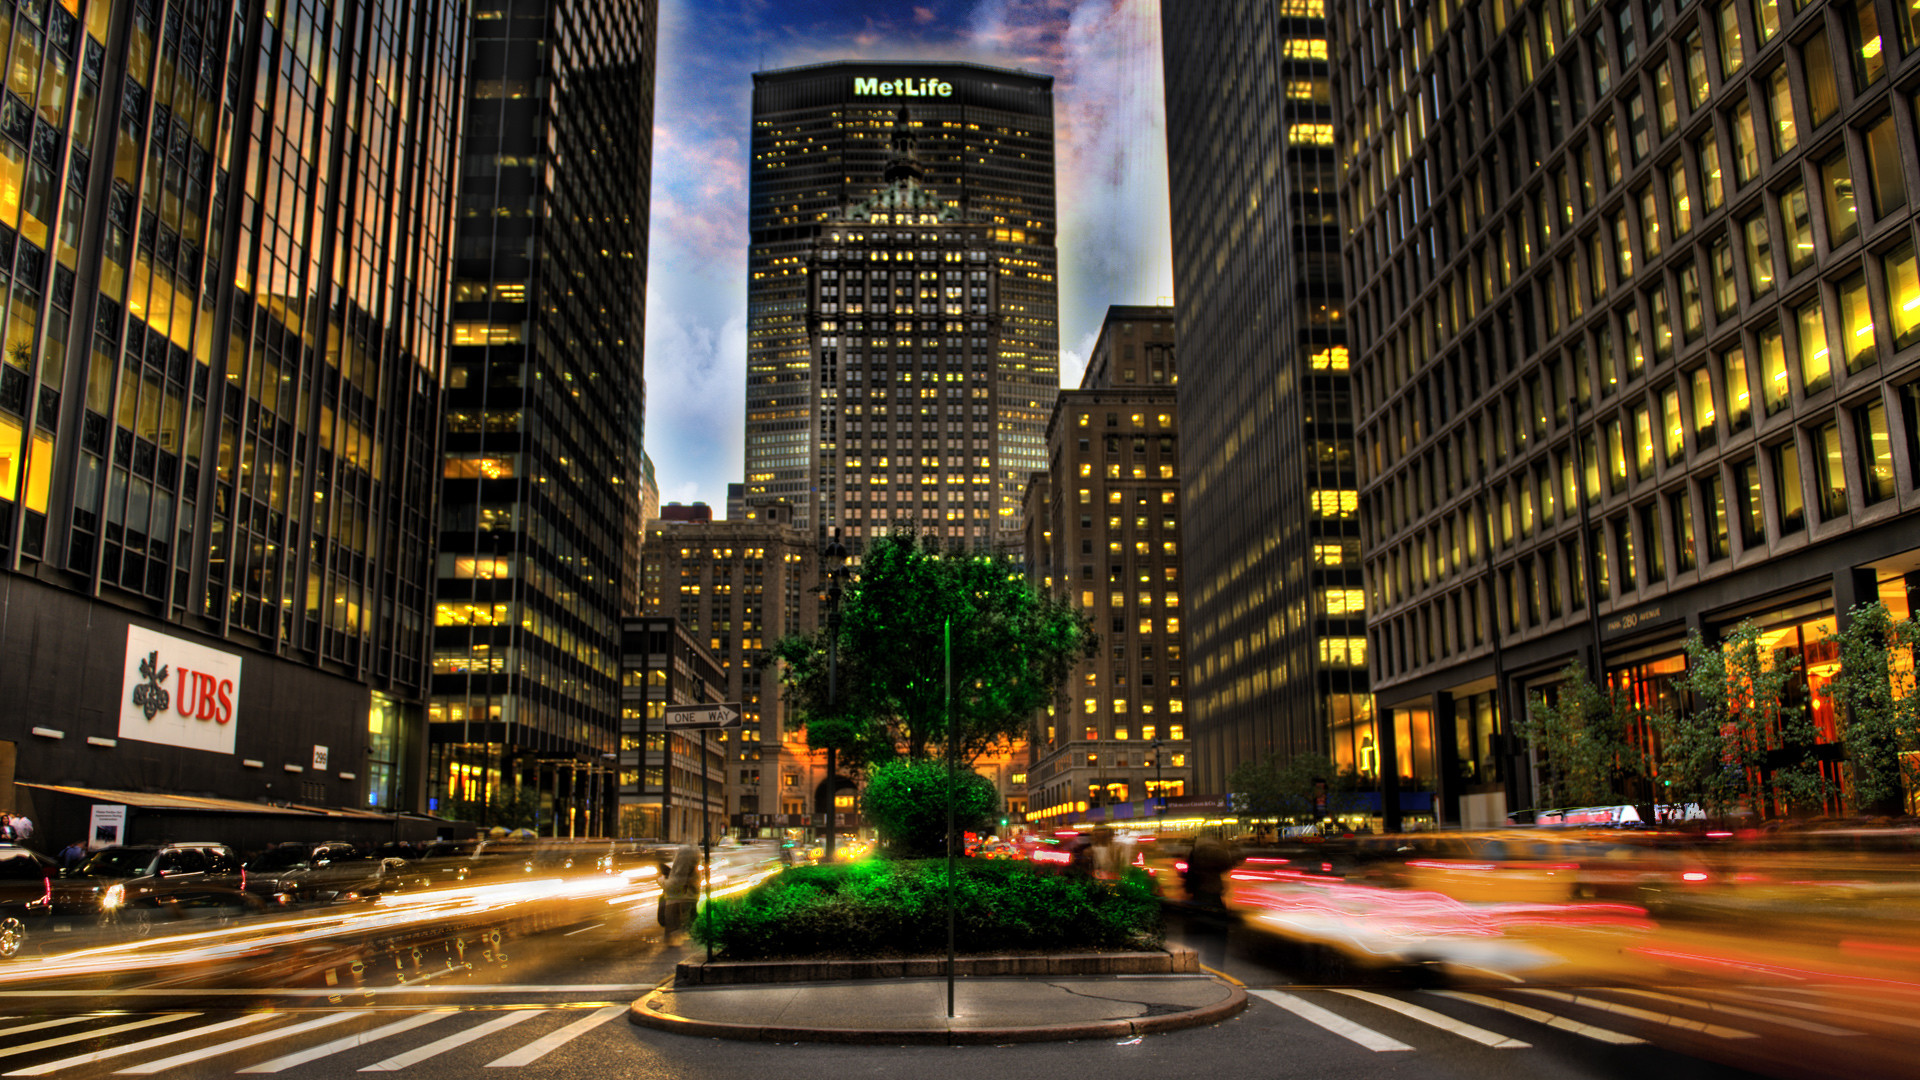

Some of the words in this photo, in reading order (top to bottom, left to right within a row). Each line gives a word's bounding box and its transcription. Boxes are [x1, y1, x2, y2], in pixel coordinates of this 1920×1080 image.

[854, 77, 953, 97] MetLife
[1622, 613, 1638, 629] 280
[1639, 607, 1661, 621] AVENUE
[176, 666, 233, 725] UBS
[674, 712, 696, 723] ONE
[708, 710, 730, 721] WAY
